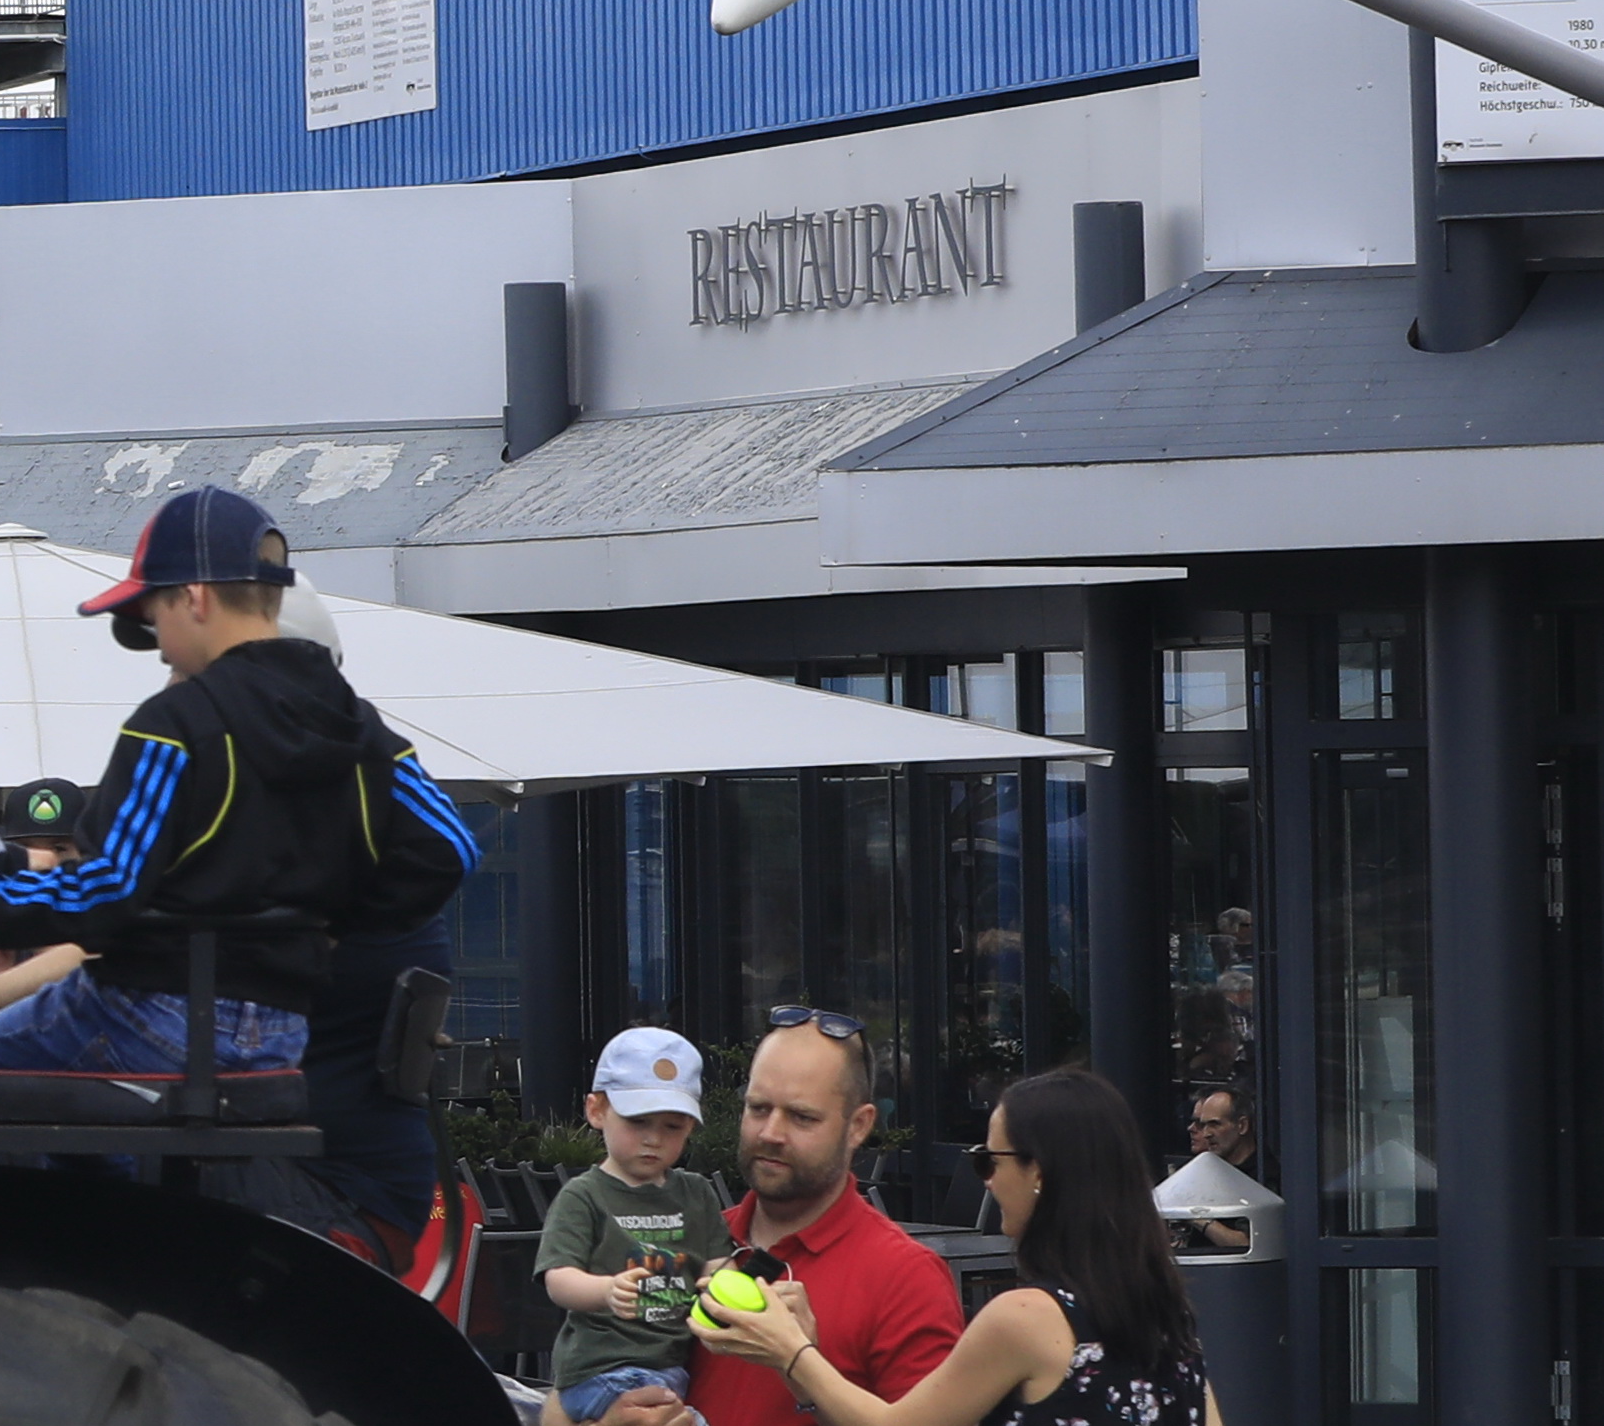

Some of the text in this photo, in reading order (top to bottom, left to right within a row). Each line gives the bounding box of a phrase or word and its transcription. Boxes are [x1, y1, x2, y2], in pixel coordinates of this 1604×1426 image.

[1568, 19, 1595, 32] 1980
[1478, 80, 1542, 93] Reichweite:
[687, 174, 1016, 332] RESTAURANT
